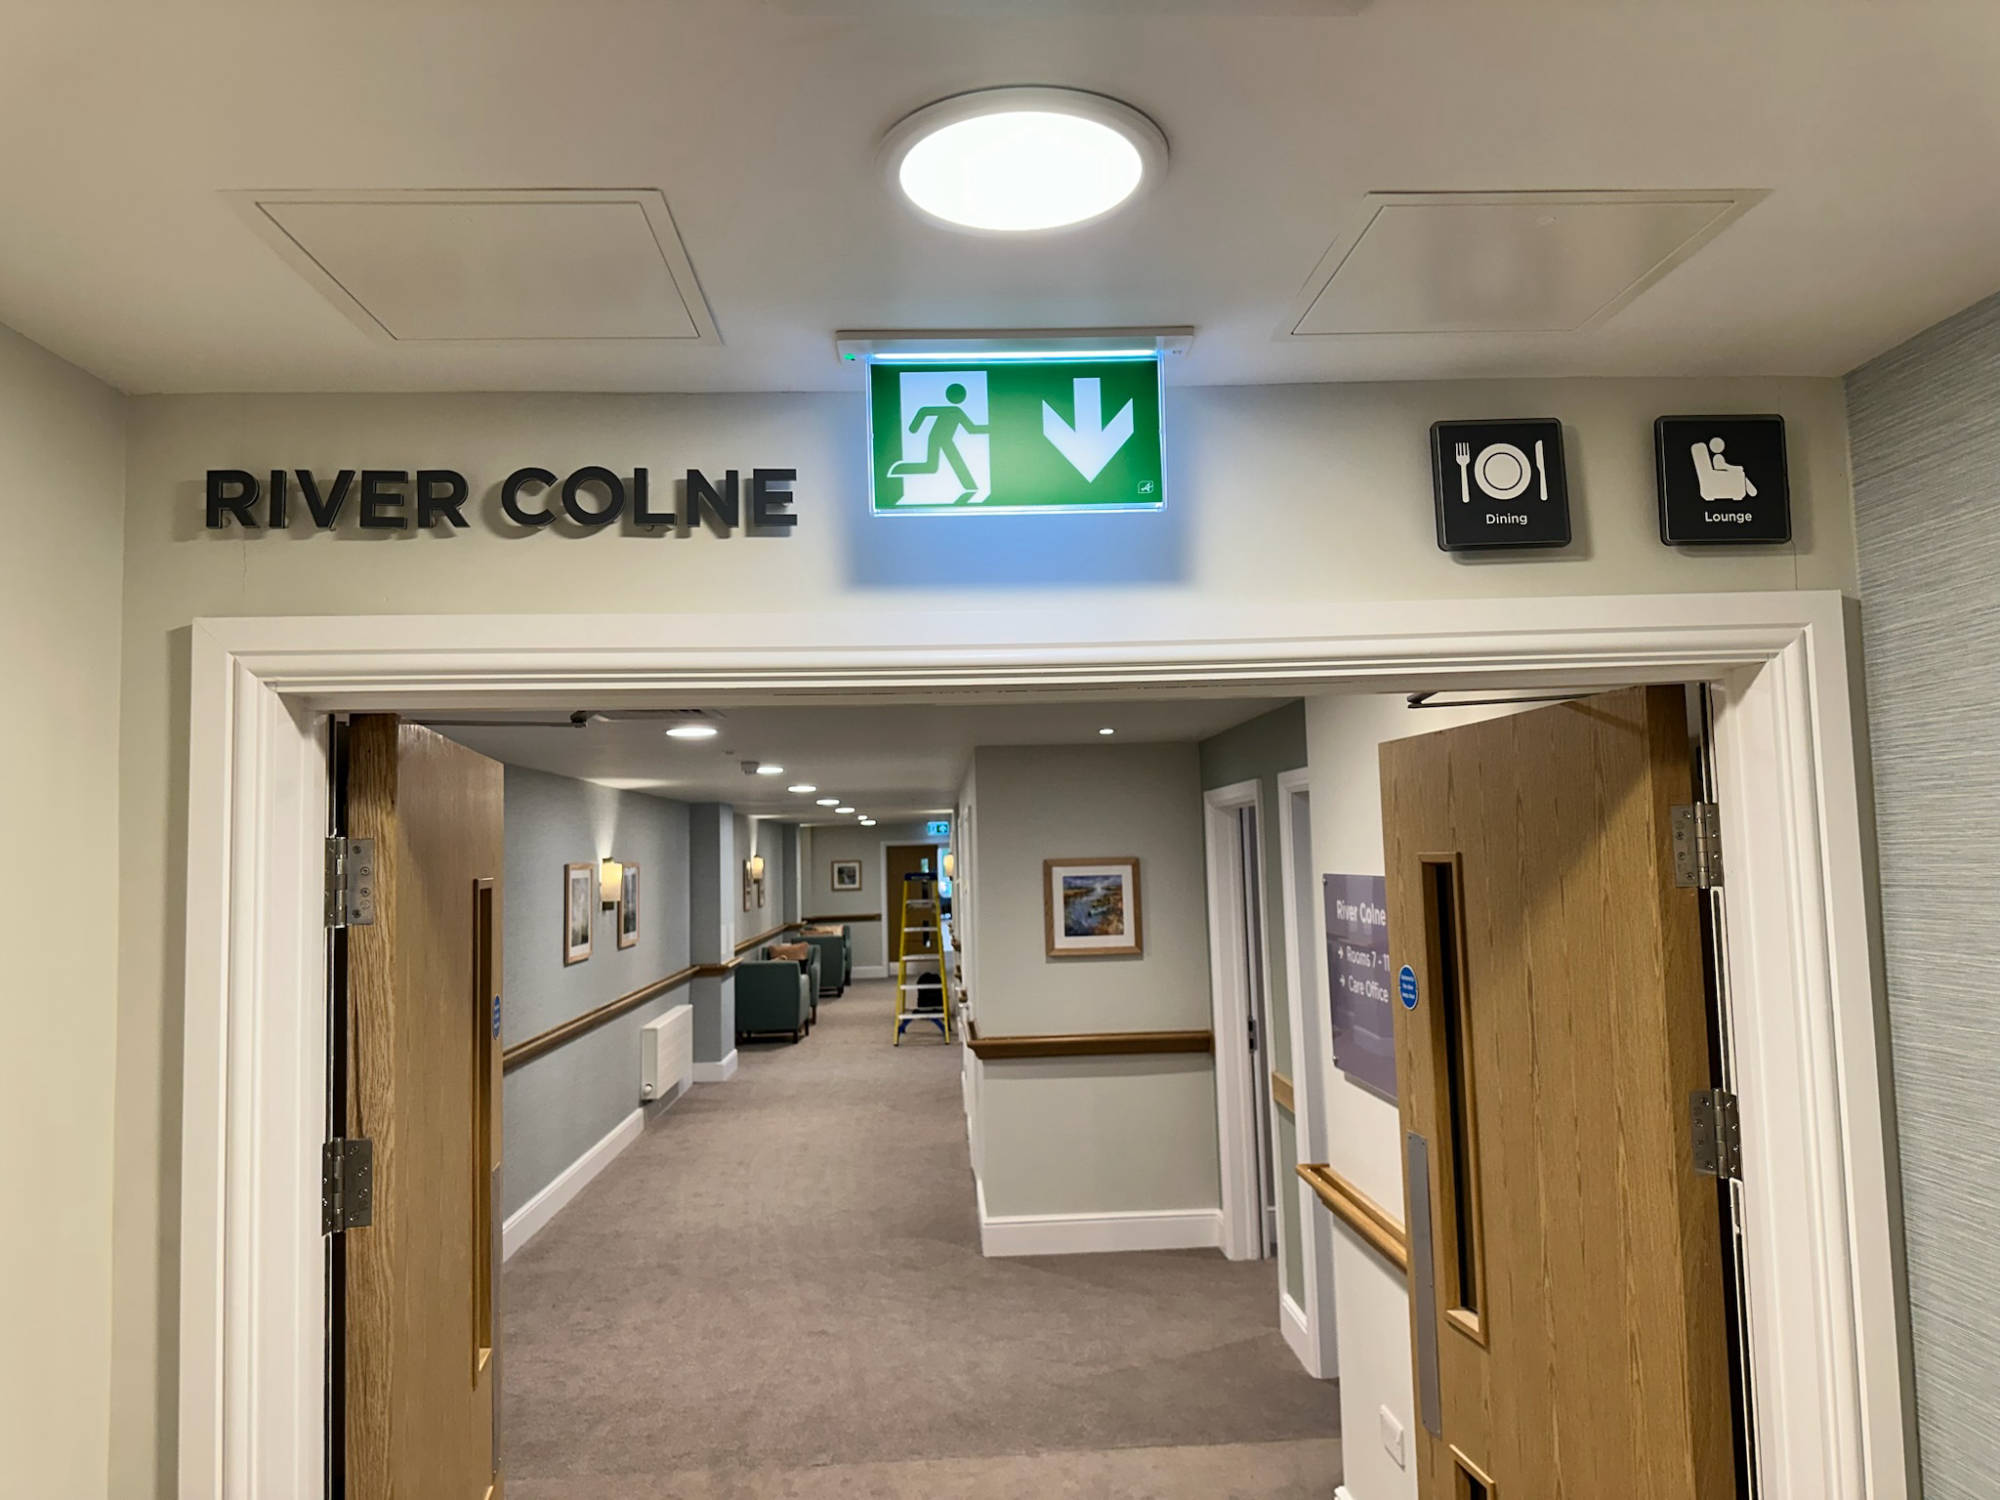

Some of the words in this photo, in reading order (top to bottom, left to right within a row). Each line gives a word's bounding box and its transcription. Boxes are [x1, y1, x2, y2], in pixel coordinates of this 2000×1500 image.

[206, 468, 470, 529] RIVER
[501, 466, 798, 529] COLNE
[1485, 512, 1528, 526] Dining
[1704, 511, 1753, 524] Lounge
[1336, 899, 1358, 921] River
[1360, 902, 1386, 926] Colne
[1346, 945, 1371, 968] Rooms
[1371, 951, 1377, 968] 7
[1348, 975, 1364, 996] Care
[1365, 980, 1389, 1003] Office
